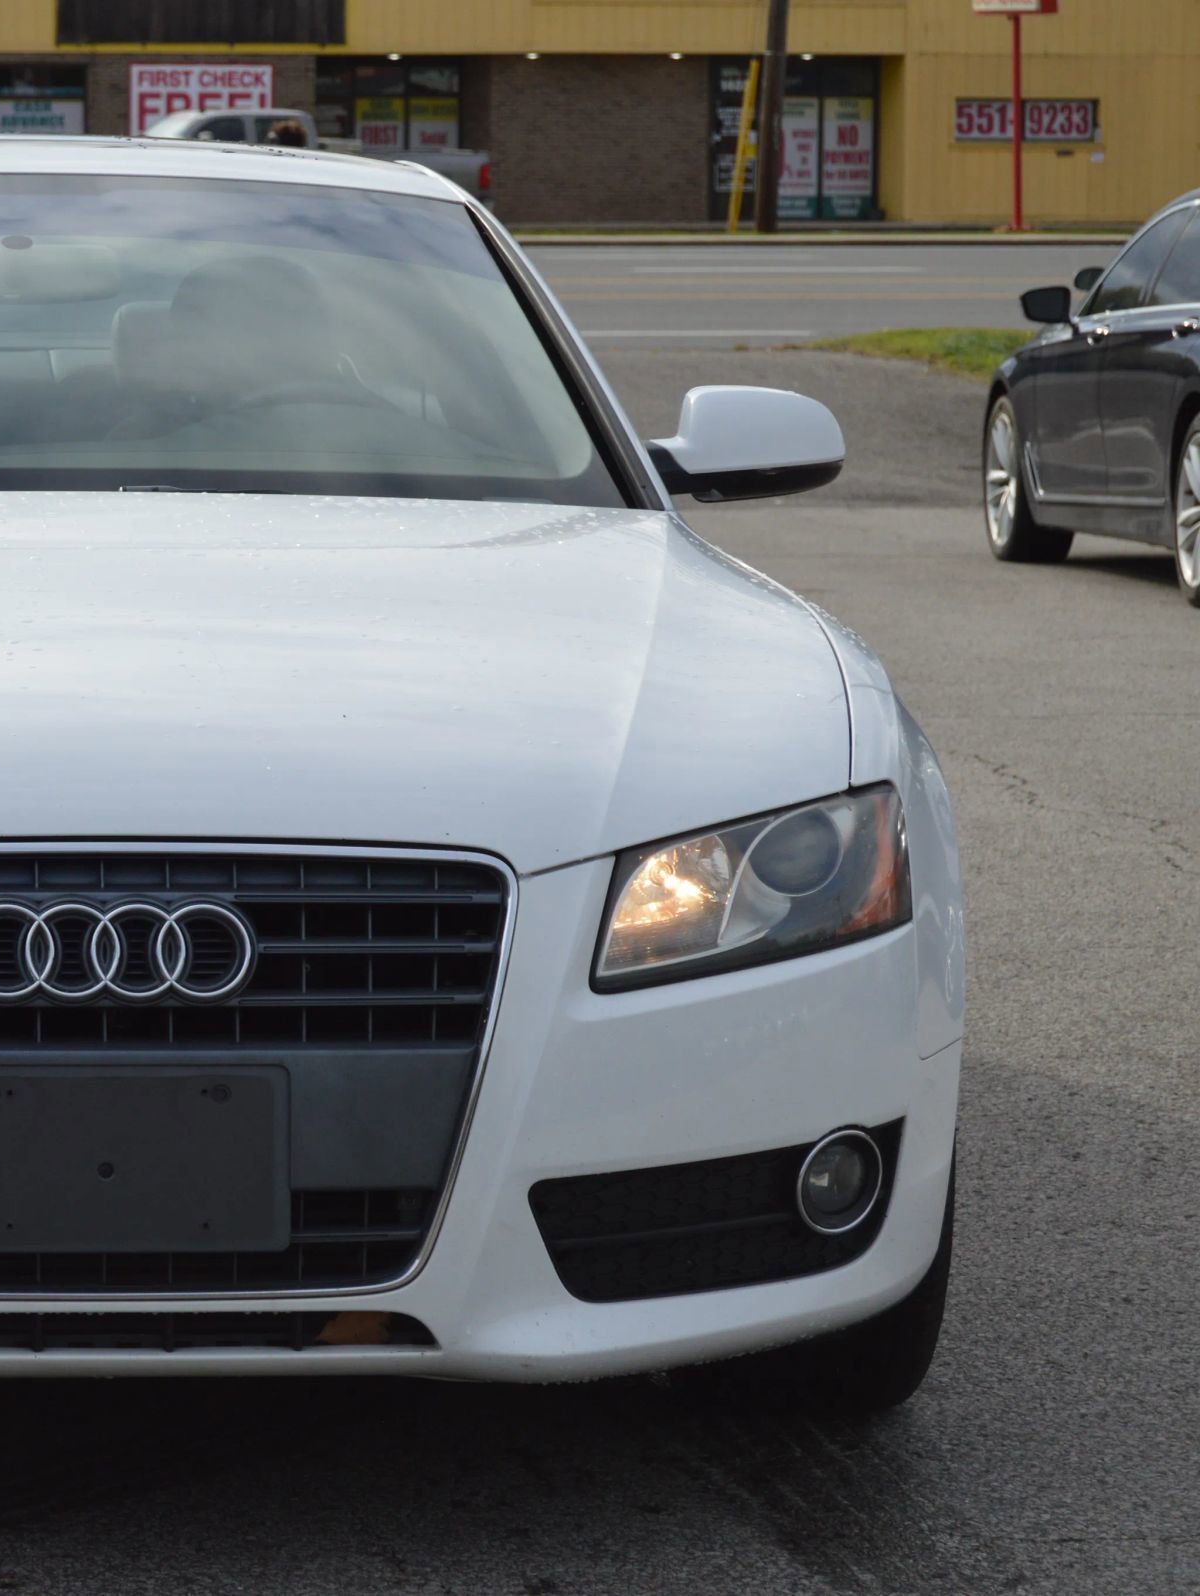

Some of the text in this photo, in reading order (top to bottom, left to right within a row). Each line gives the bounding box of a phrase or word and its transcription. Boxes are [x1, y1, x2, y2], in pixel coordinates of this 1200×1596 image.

[138, 71, 266, 87] FIRST CHECK
[836, 123, 859, 146] NO
